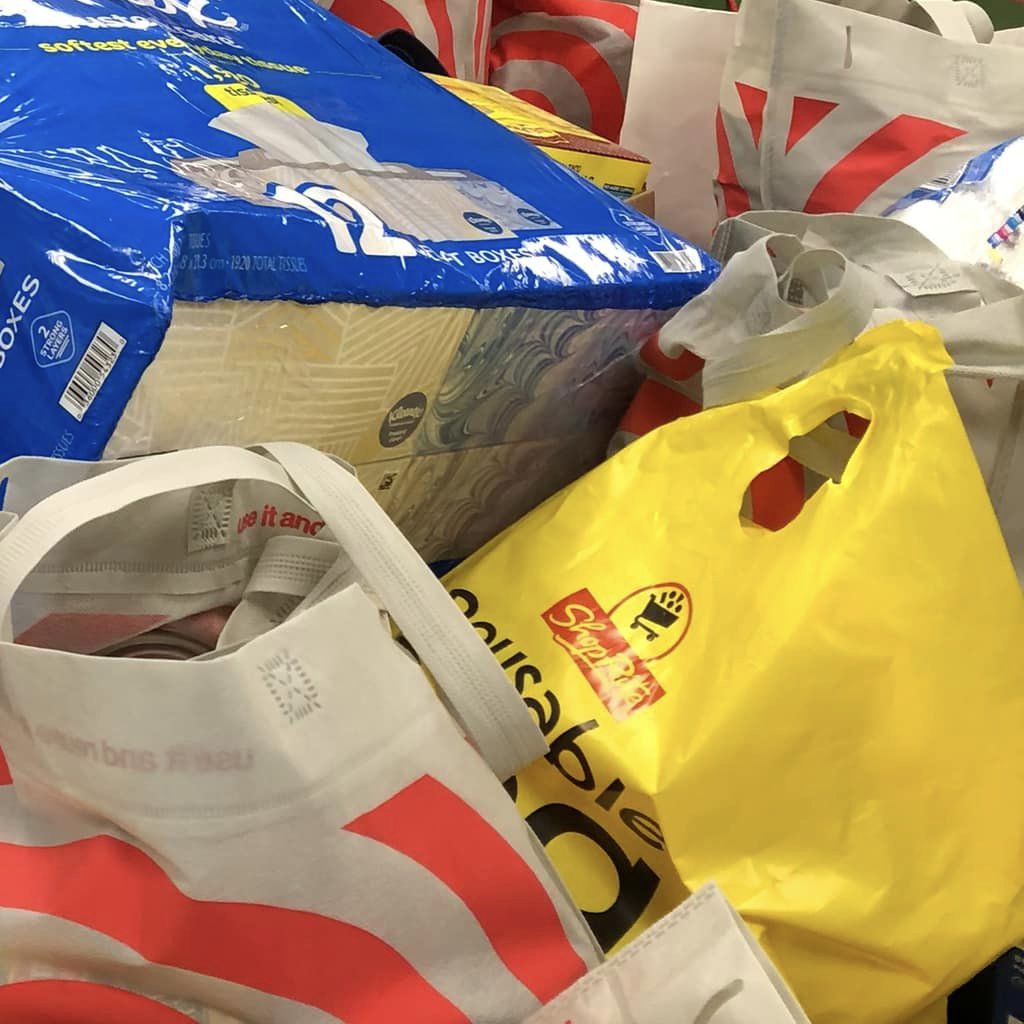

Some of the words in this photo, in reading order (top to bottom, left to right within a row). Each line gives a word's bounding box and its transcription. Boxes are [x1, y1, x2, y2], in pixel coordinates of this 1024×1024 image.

[38, 38, 130, 53] softest
[38, 325, 51, 339] 2
[40, 319, 64, 357] STRONG
[46, 326, 69, 361] LAYERS
[262, 504, 278, 526] it
